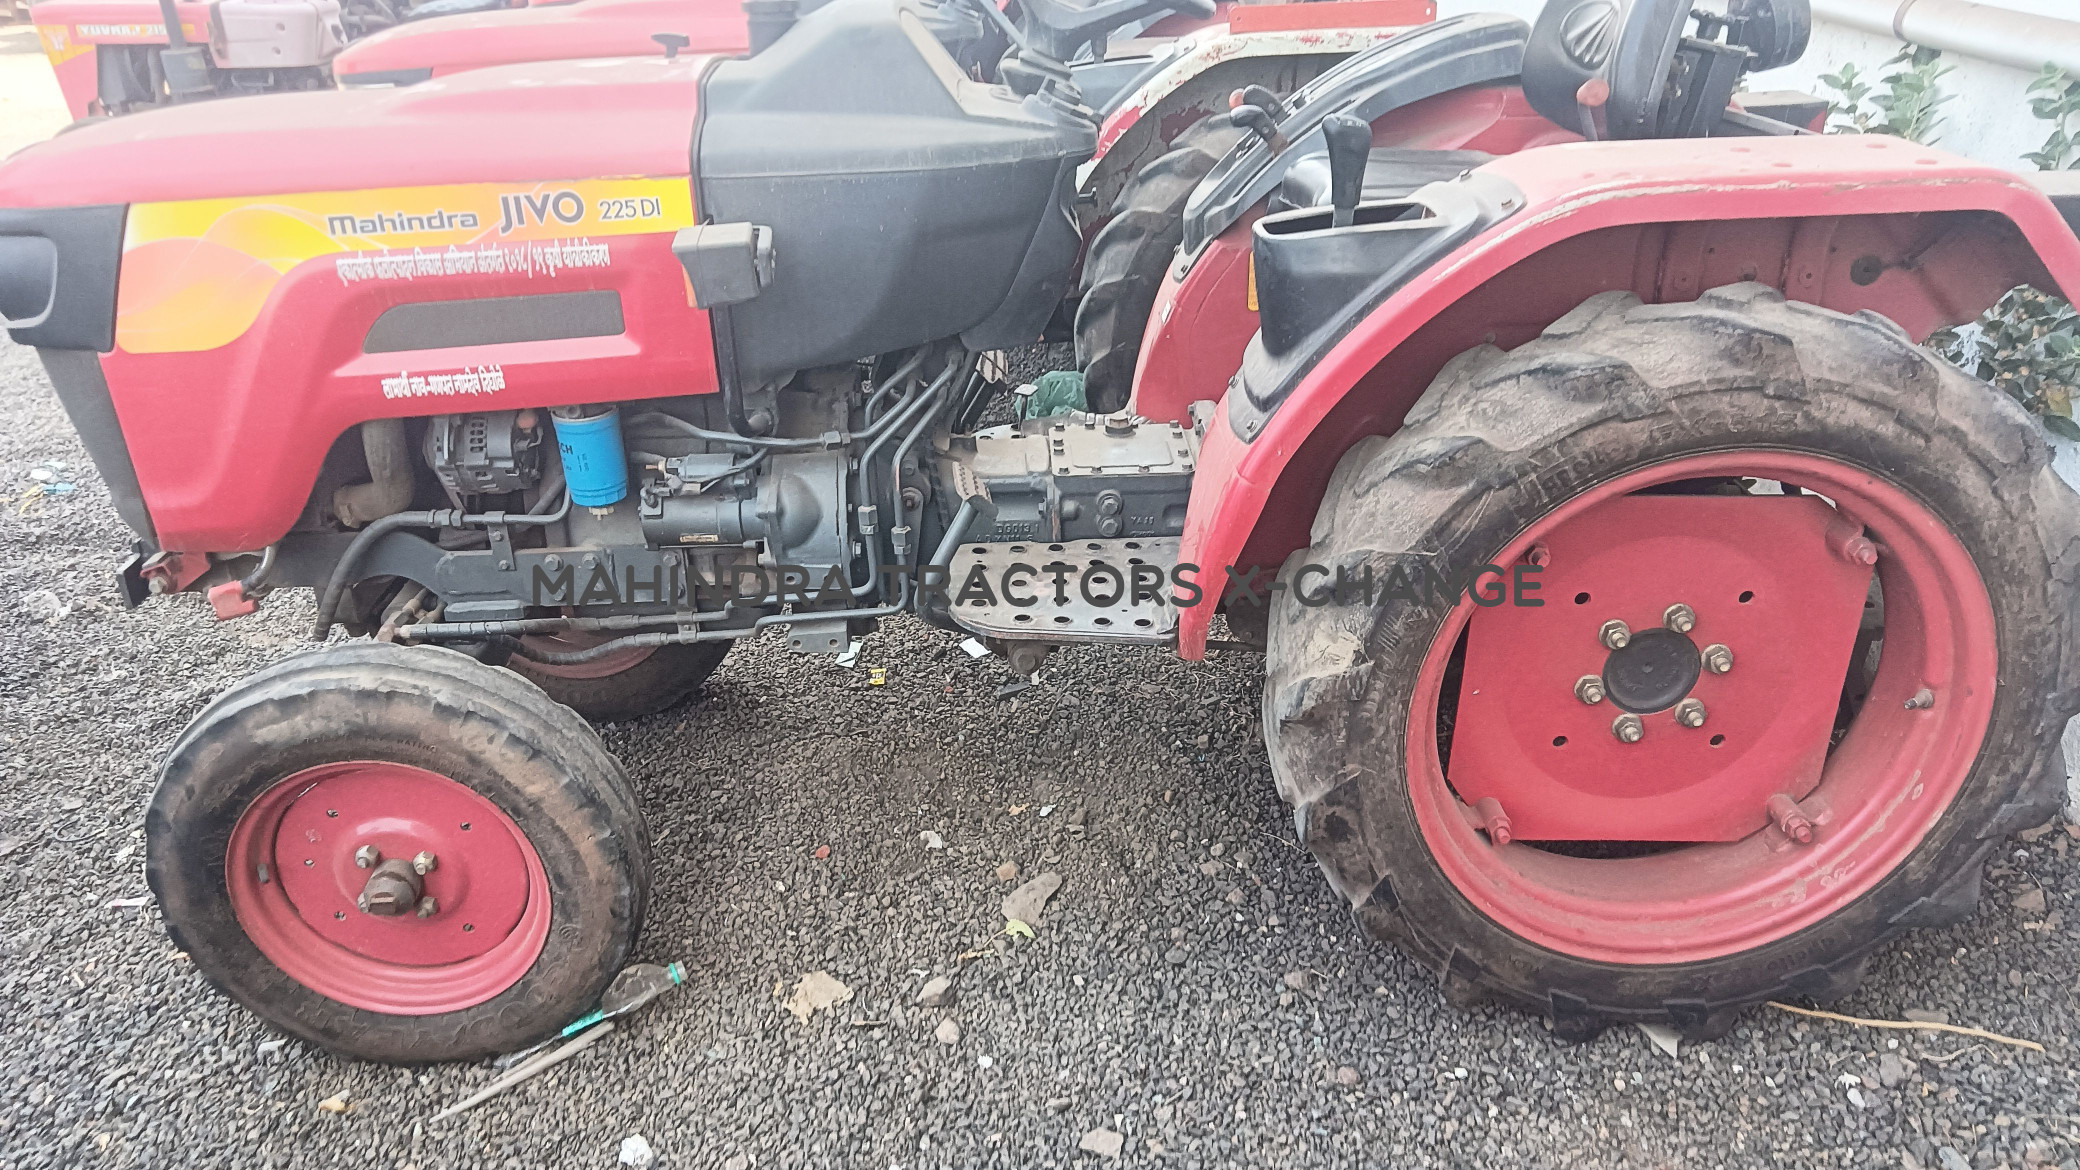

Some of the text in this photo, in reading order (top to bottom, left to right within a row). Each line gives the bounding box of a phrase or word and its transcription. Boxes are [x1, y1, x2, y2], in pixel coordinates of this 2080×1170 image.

[500, 190, 585, 235] JIVO
[599, 200, 637, 220] 225
[640, 197, 661, 217] DI
